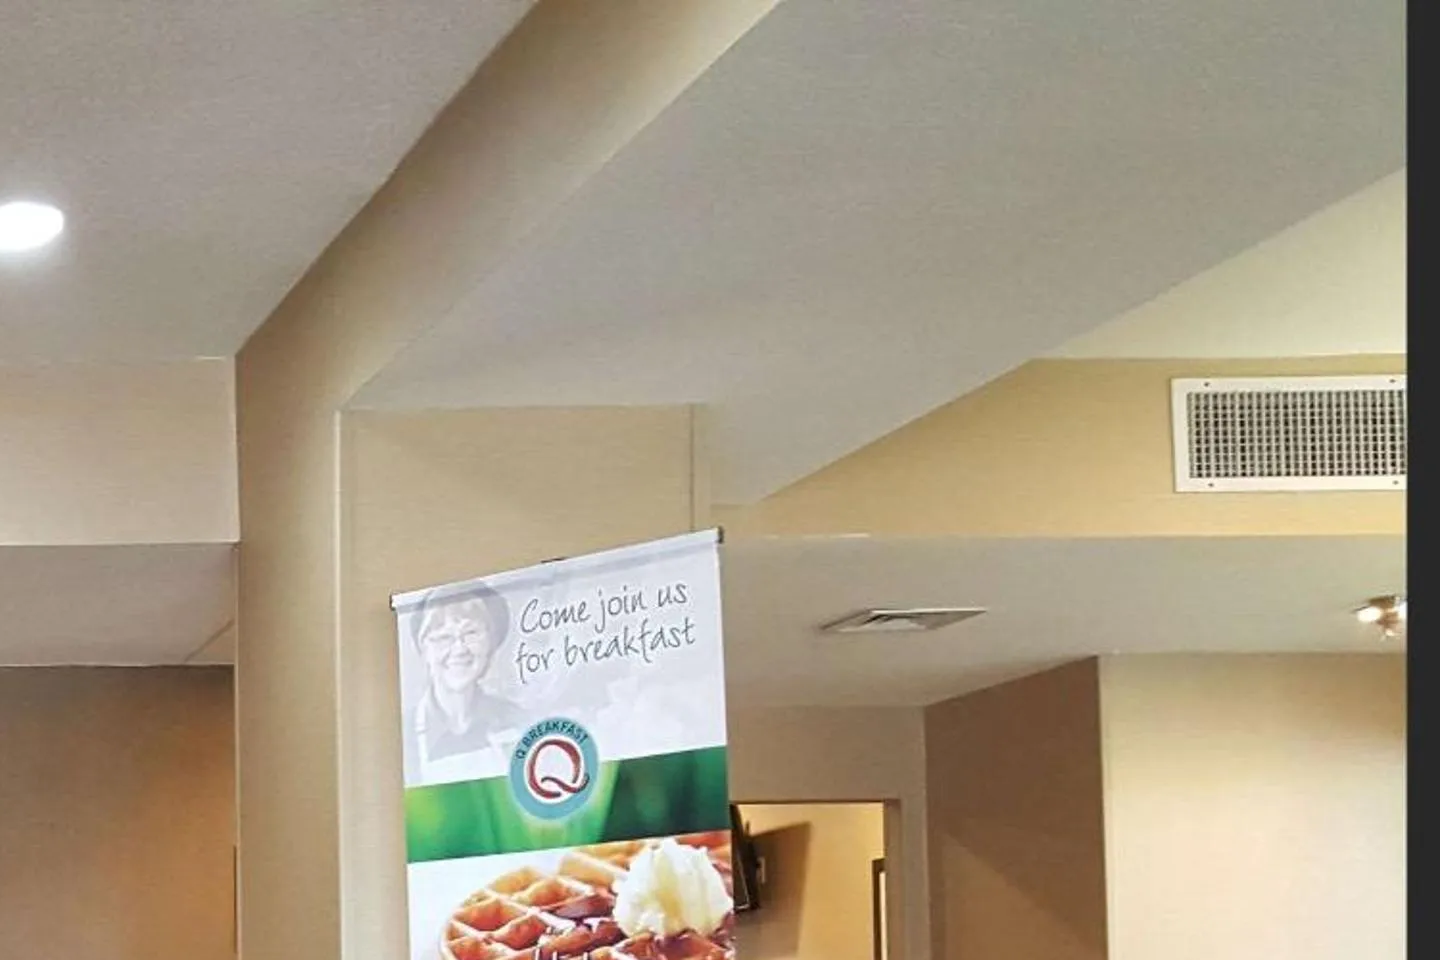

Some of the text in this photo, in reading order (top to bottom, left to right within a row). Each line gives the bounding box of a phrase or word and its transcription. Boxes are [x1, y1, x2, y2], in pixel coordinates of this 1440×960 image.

[520, 581, 688, 634] Come join us
[515, 617, 696, 684] for breakfast
[522, 721, 589, 748] BREAKFAST
[527, 738, 590, 798] Q
